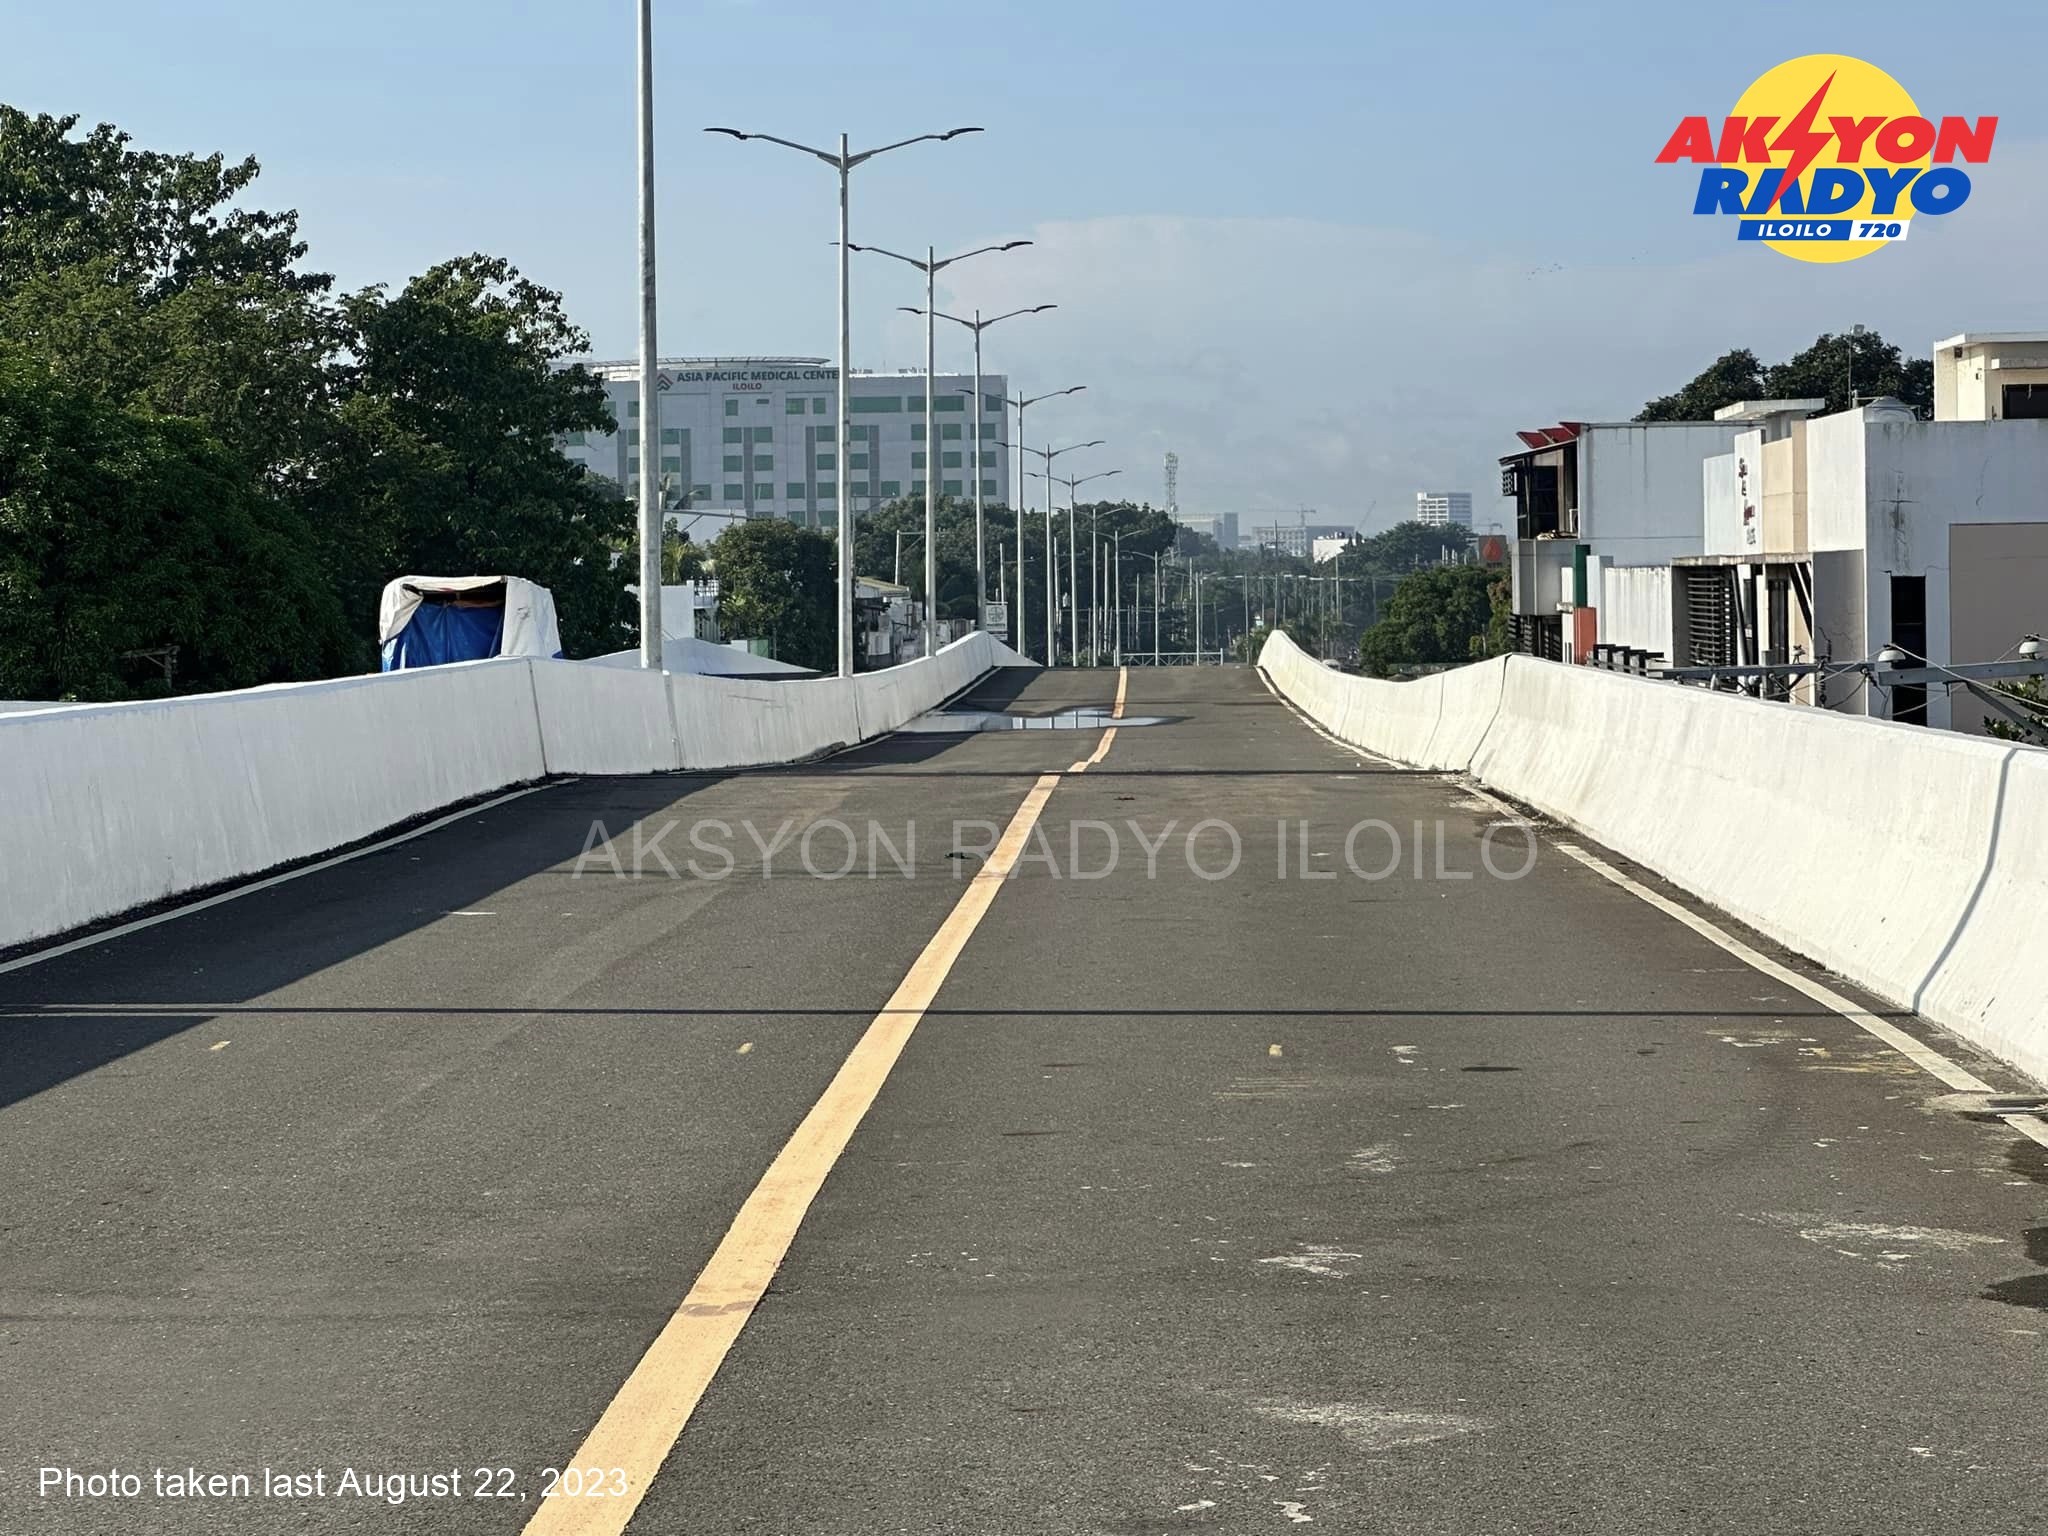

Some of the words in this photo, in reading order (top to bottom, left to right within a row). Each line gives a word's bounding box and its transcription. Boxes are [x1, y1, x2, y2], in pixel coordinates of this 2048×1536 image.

[676, 371, 704, 382] ASIA
[705, 370, 748, 382] PACIFIC
[750, 370, 800, 381] MEDICAL
[802, 370, 840, 380] CENTE
[732, 382, 762, 391] ILOILO
